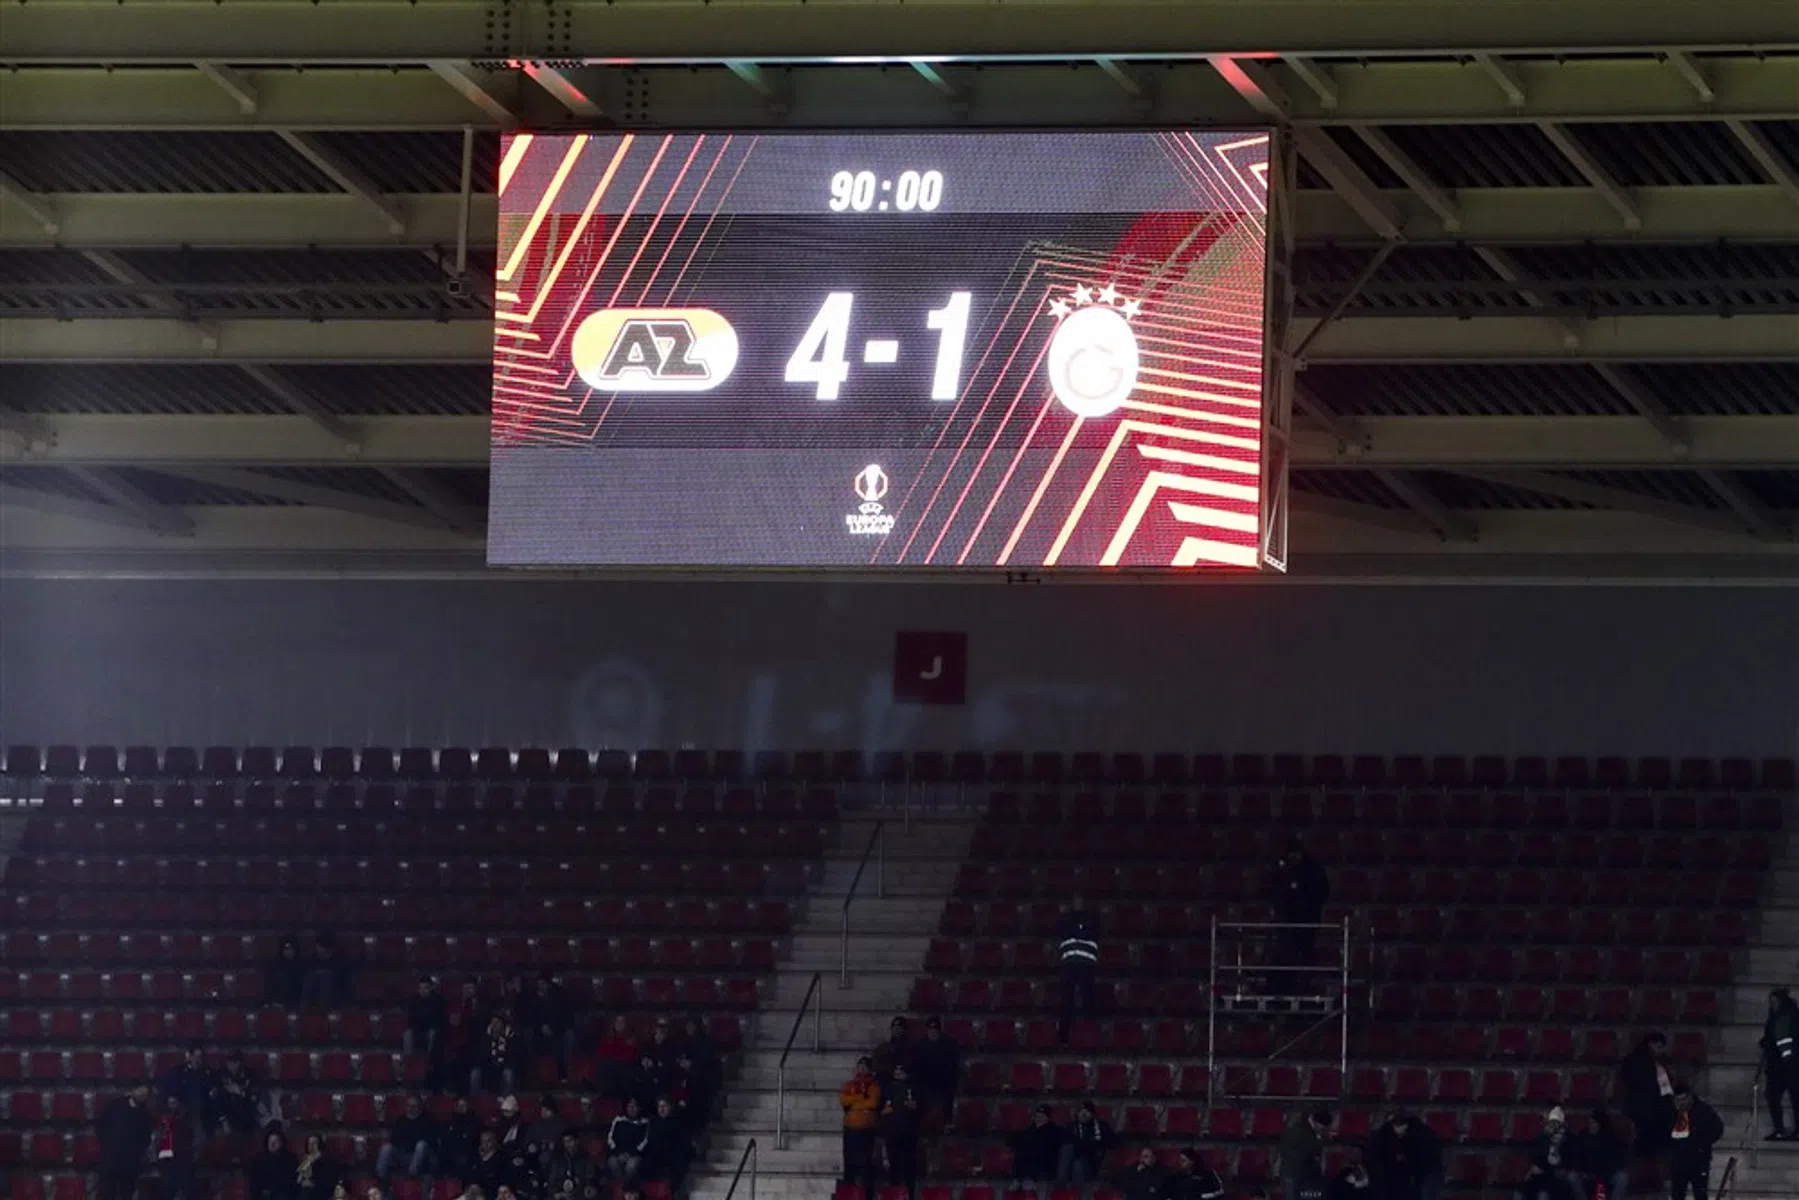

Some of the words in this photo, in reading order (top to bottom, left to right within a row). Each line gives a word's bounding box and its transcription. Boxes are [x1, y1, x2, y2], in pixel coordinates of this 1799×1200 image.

[829, 170, 943, 212] 90:00
[600, 318, 711, 379] AZ
[919, 655, 942, 680] J
